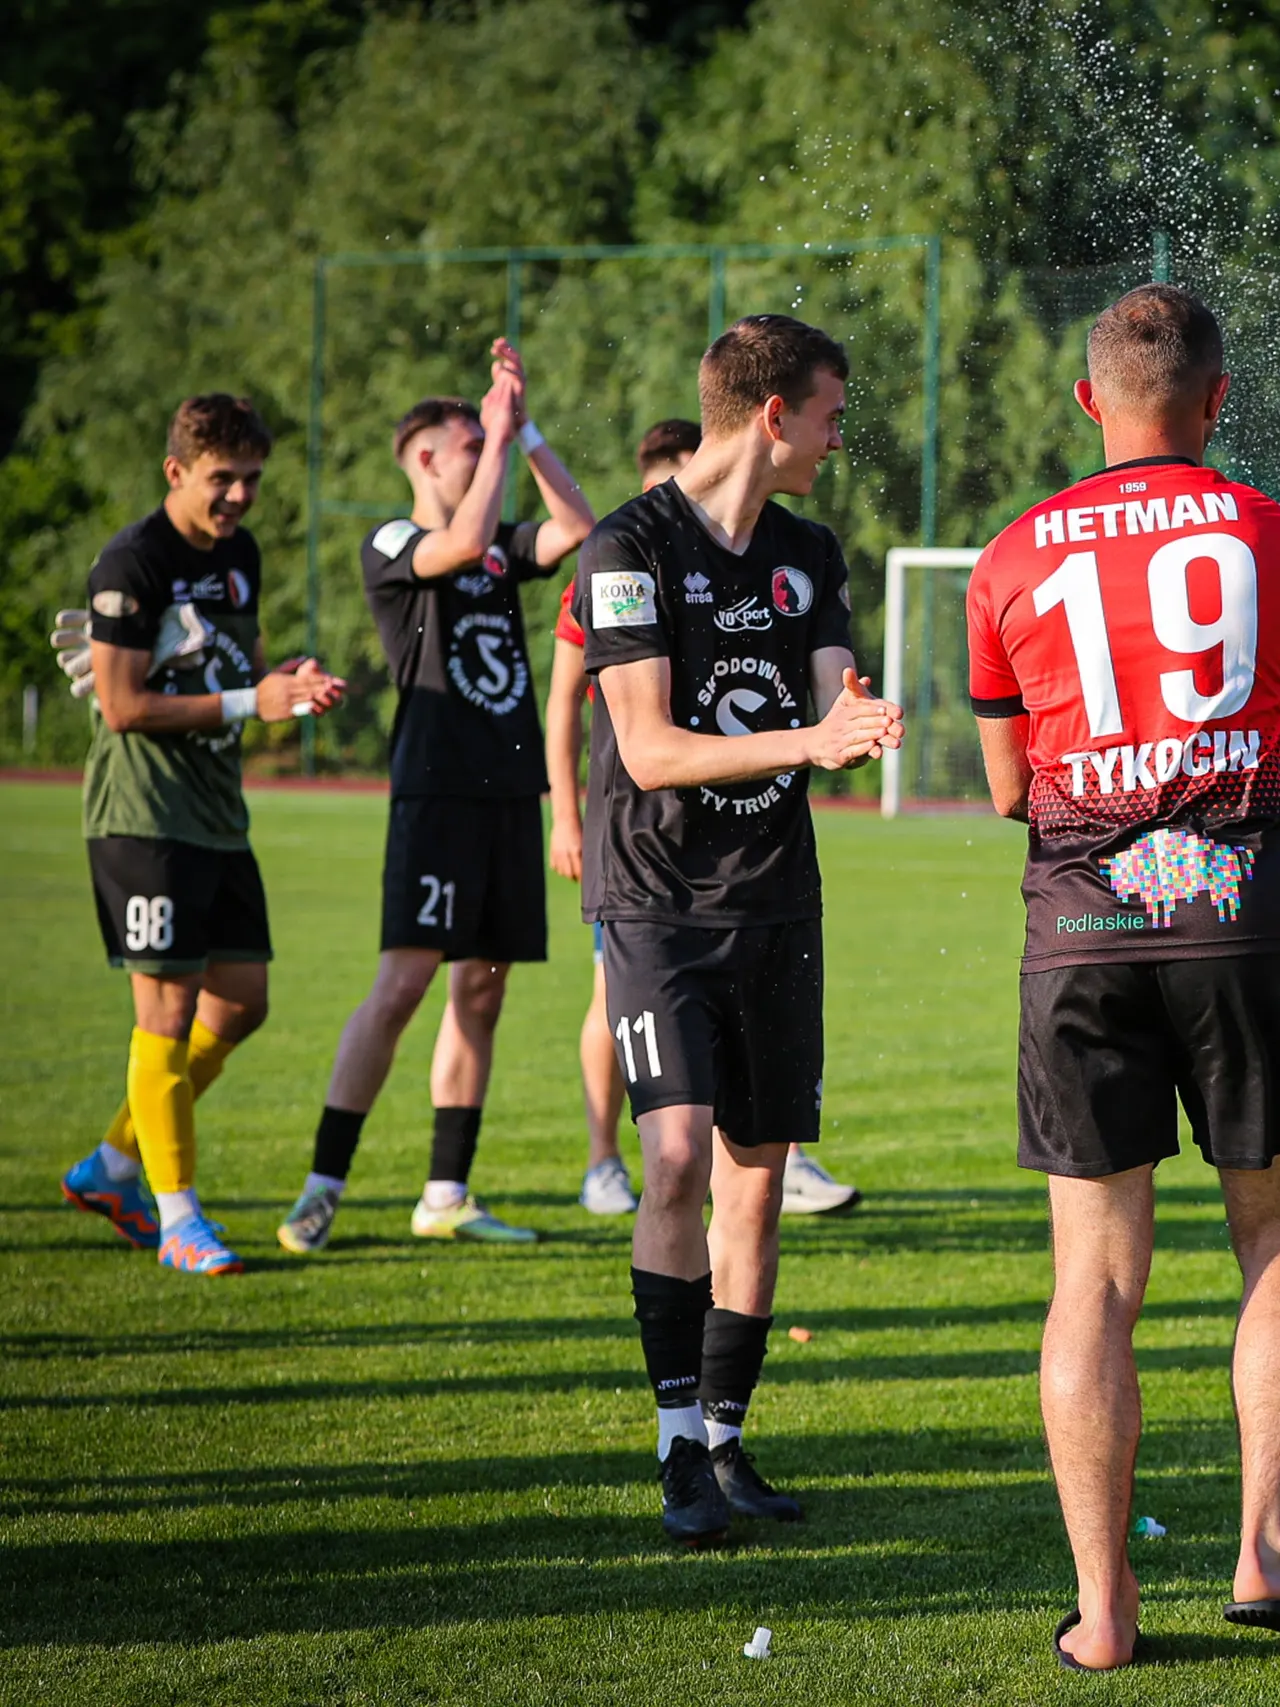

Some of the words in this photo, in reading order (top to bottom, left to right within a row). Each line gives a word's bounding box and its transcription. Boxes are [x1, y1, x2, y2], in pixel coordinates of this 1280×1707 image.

[1118, 481, 1147, 493] 1959
[1034, 493, 1239, 549] HETMAN
[600, 583, 646, 598] KOMA
[1033, 532, 1258, 739] 19
[1060, 730, 1260, 798] TYKOCIN
[732, 785, 780, 815] TRUE
[126, 896, 173, 951] 98
[417, 874, 456, 929] 21
[1056, 913, 1145, 934] Podlaskie
[615, 1010, 662, 1083] 11
